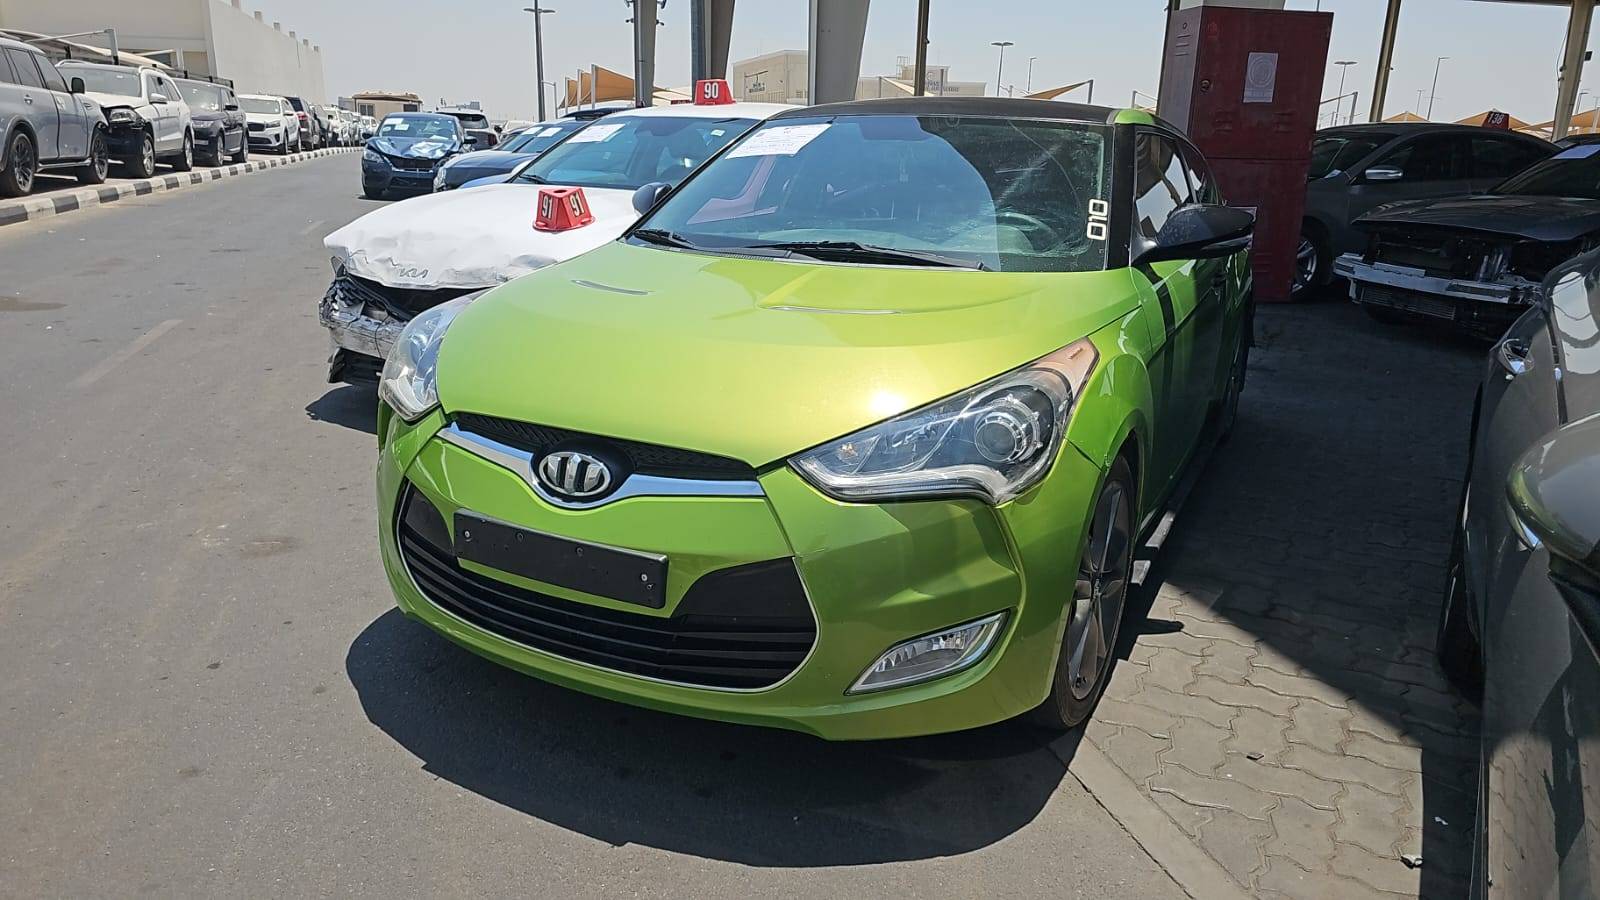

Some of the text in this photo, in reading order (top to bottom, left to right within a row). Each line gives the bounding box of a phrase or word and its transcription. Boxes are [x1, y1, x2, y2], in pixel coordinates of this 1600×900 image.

[704, 82, 719, 99] 90
[541, 195, 553, 219] 91
[569, 192, 585, 217] 91
[1086, 198, 1108, 241] 010
